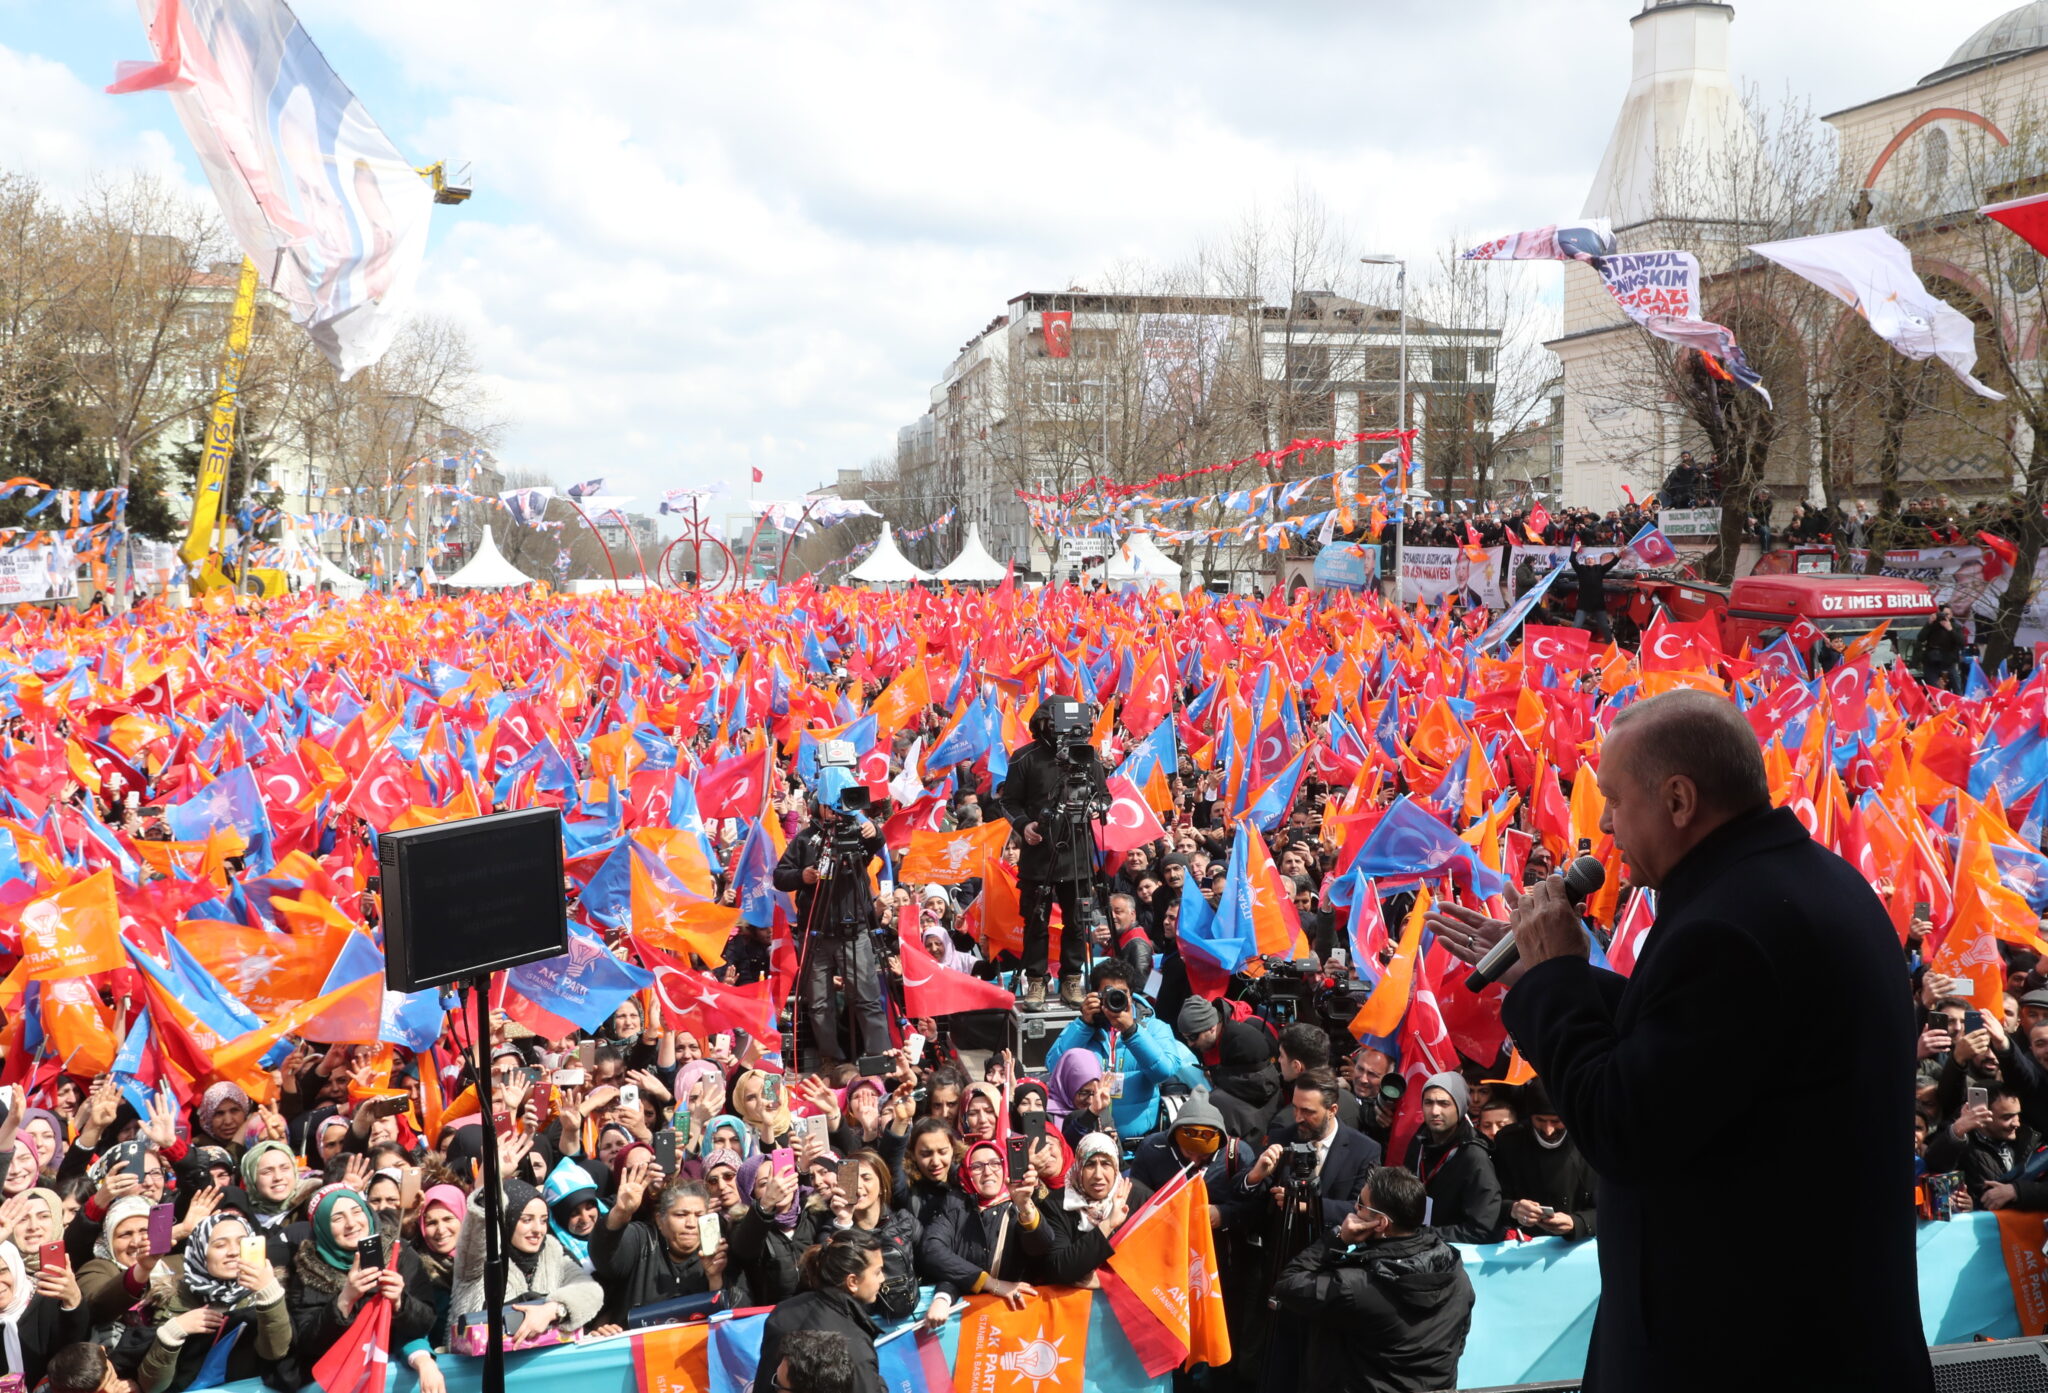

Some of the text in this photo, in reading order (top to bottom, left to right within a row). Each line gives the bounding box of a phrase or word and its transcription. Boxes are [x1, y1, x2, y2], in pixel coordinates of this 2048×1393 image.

[1822, 593, 1934, 611] ÖZ İMES BİRLİK
[538, 967, 590, 996] AK PARTİ
[2023, 1250, 2047, 1314] AK PARTİ
[1167, 1286, 1187, 1306] AK
[975, 1314, 990, 1351] İSTANBUL
[988, 1325, 1002, 1348] AK
